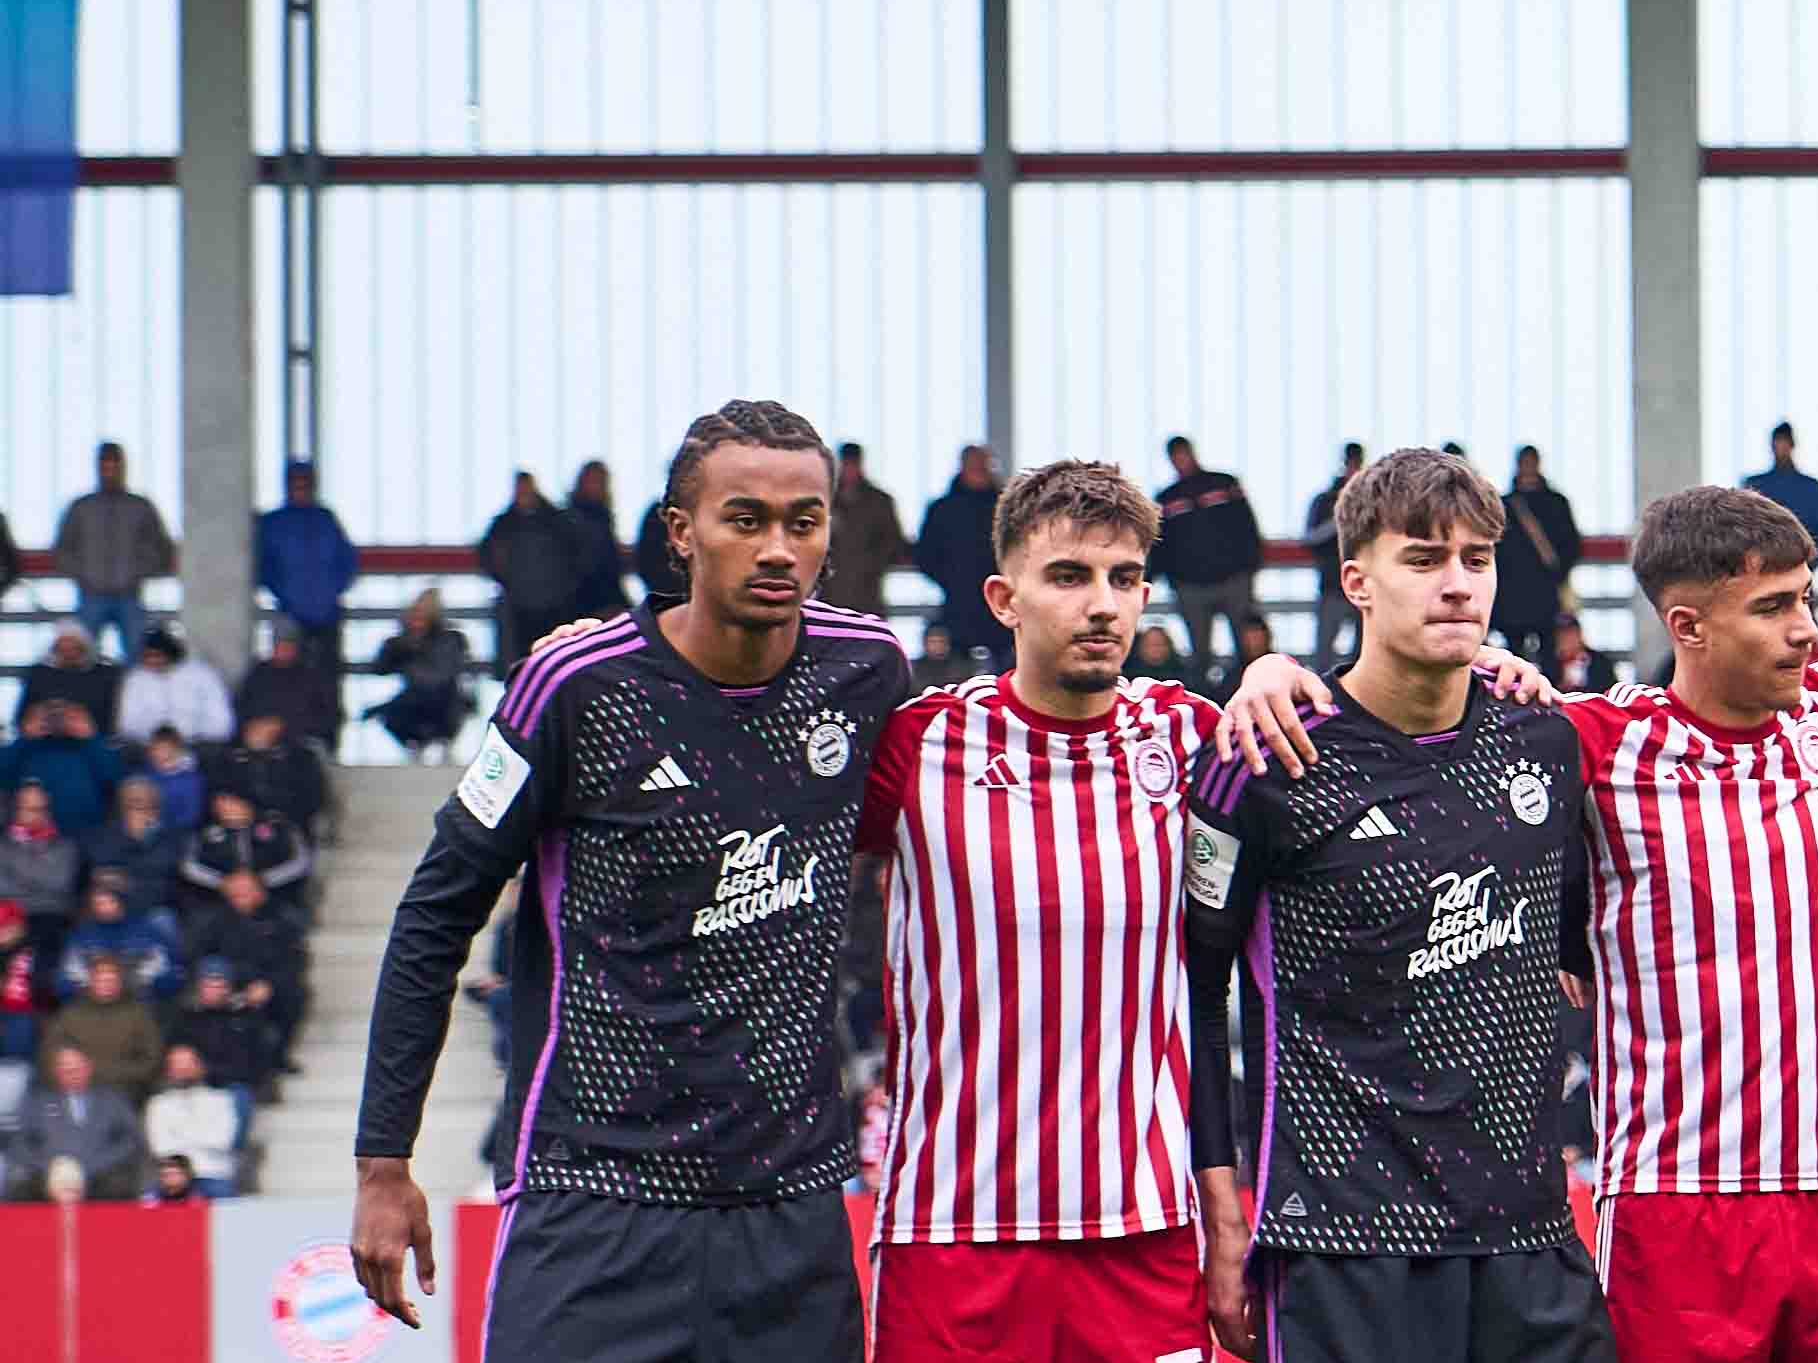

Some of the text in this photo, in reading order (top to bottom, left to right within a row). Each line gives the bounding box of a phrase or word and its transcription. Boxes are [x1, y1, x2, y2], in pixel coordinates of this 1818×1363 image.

[715, 847, 780, 902] GEGEN
[718, 824, 785, 876] ROT
[692, 855, 819, 938] RASSISMUS
[1428, 888, 1489, 941] GEGEN
[1430, 864, 1495, 918] ROT
[1408, 898, 1529, 980] RASSISMUS
